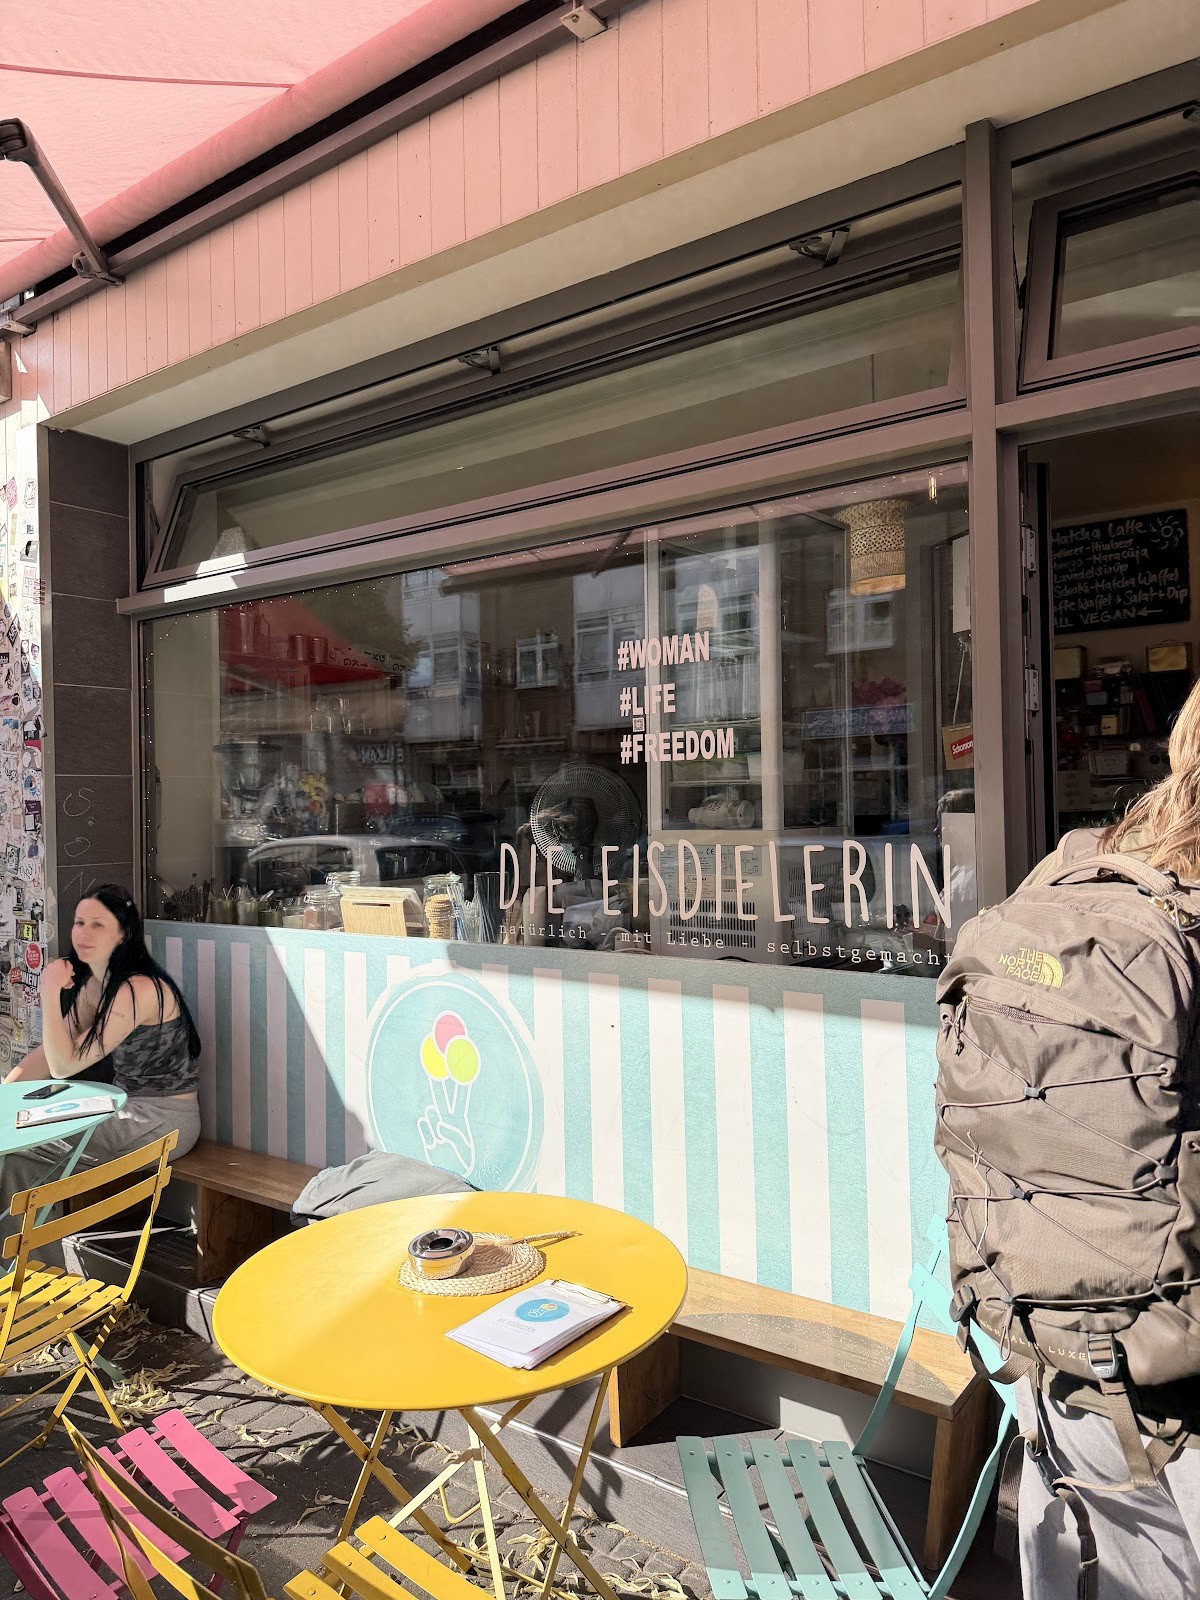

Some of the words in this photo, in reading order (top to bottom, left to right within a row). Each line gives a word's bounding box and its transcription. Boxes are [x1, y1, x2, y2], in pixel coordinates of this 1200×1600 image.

[1108, 519, 1147, 538] Latte
[1137, 567, 1179, 587] Waffel
[1167, 585, 1188, 606] Dip
[1080, 606, 1137, 625] VEGAN
[617, 630, 710, 671] #WOMAN
[619, 683, 676, 717] #LIFE
[620, 728, 735, 765] #FREEDOM
[499, 842, 565, 915] DIE
[601, 838, 952, 929] EISDIELERIN
[499, 924, 587, 939] natürlich
[620, 930, 652, 944] mit
[666, 932, 725, 949] Liebe
[767, 940, 953, 966] selbstgemacht
[1019, 947, 1043, 962] THE
[998, 954, 1044, 973] NORTH
[1006, 965, 1041, 982] FACE
[1048, 1345, 1086, 1361] LUXE
